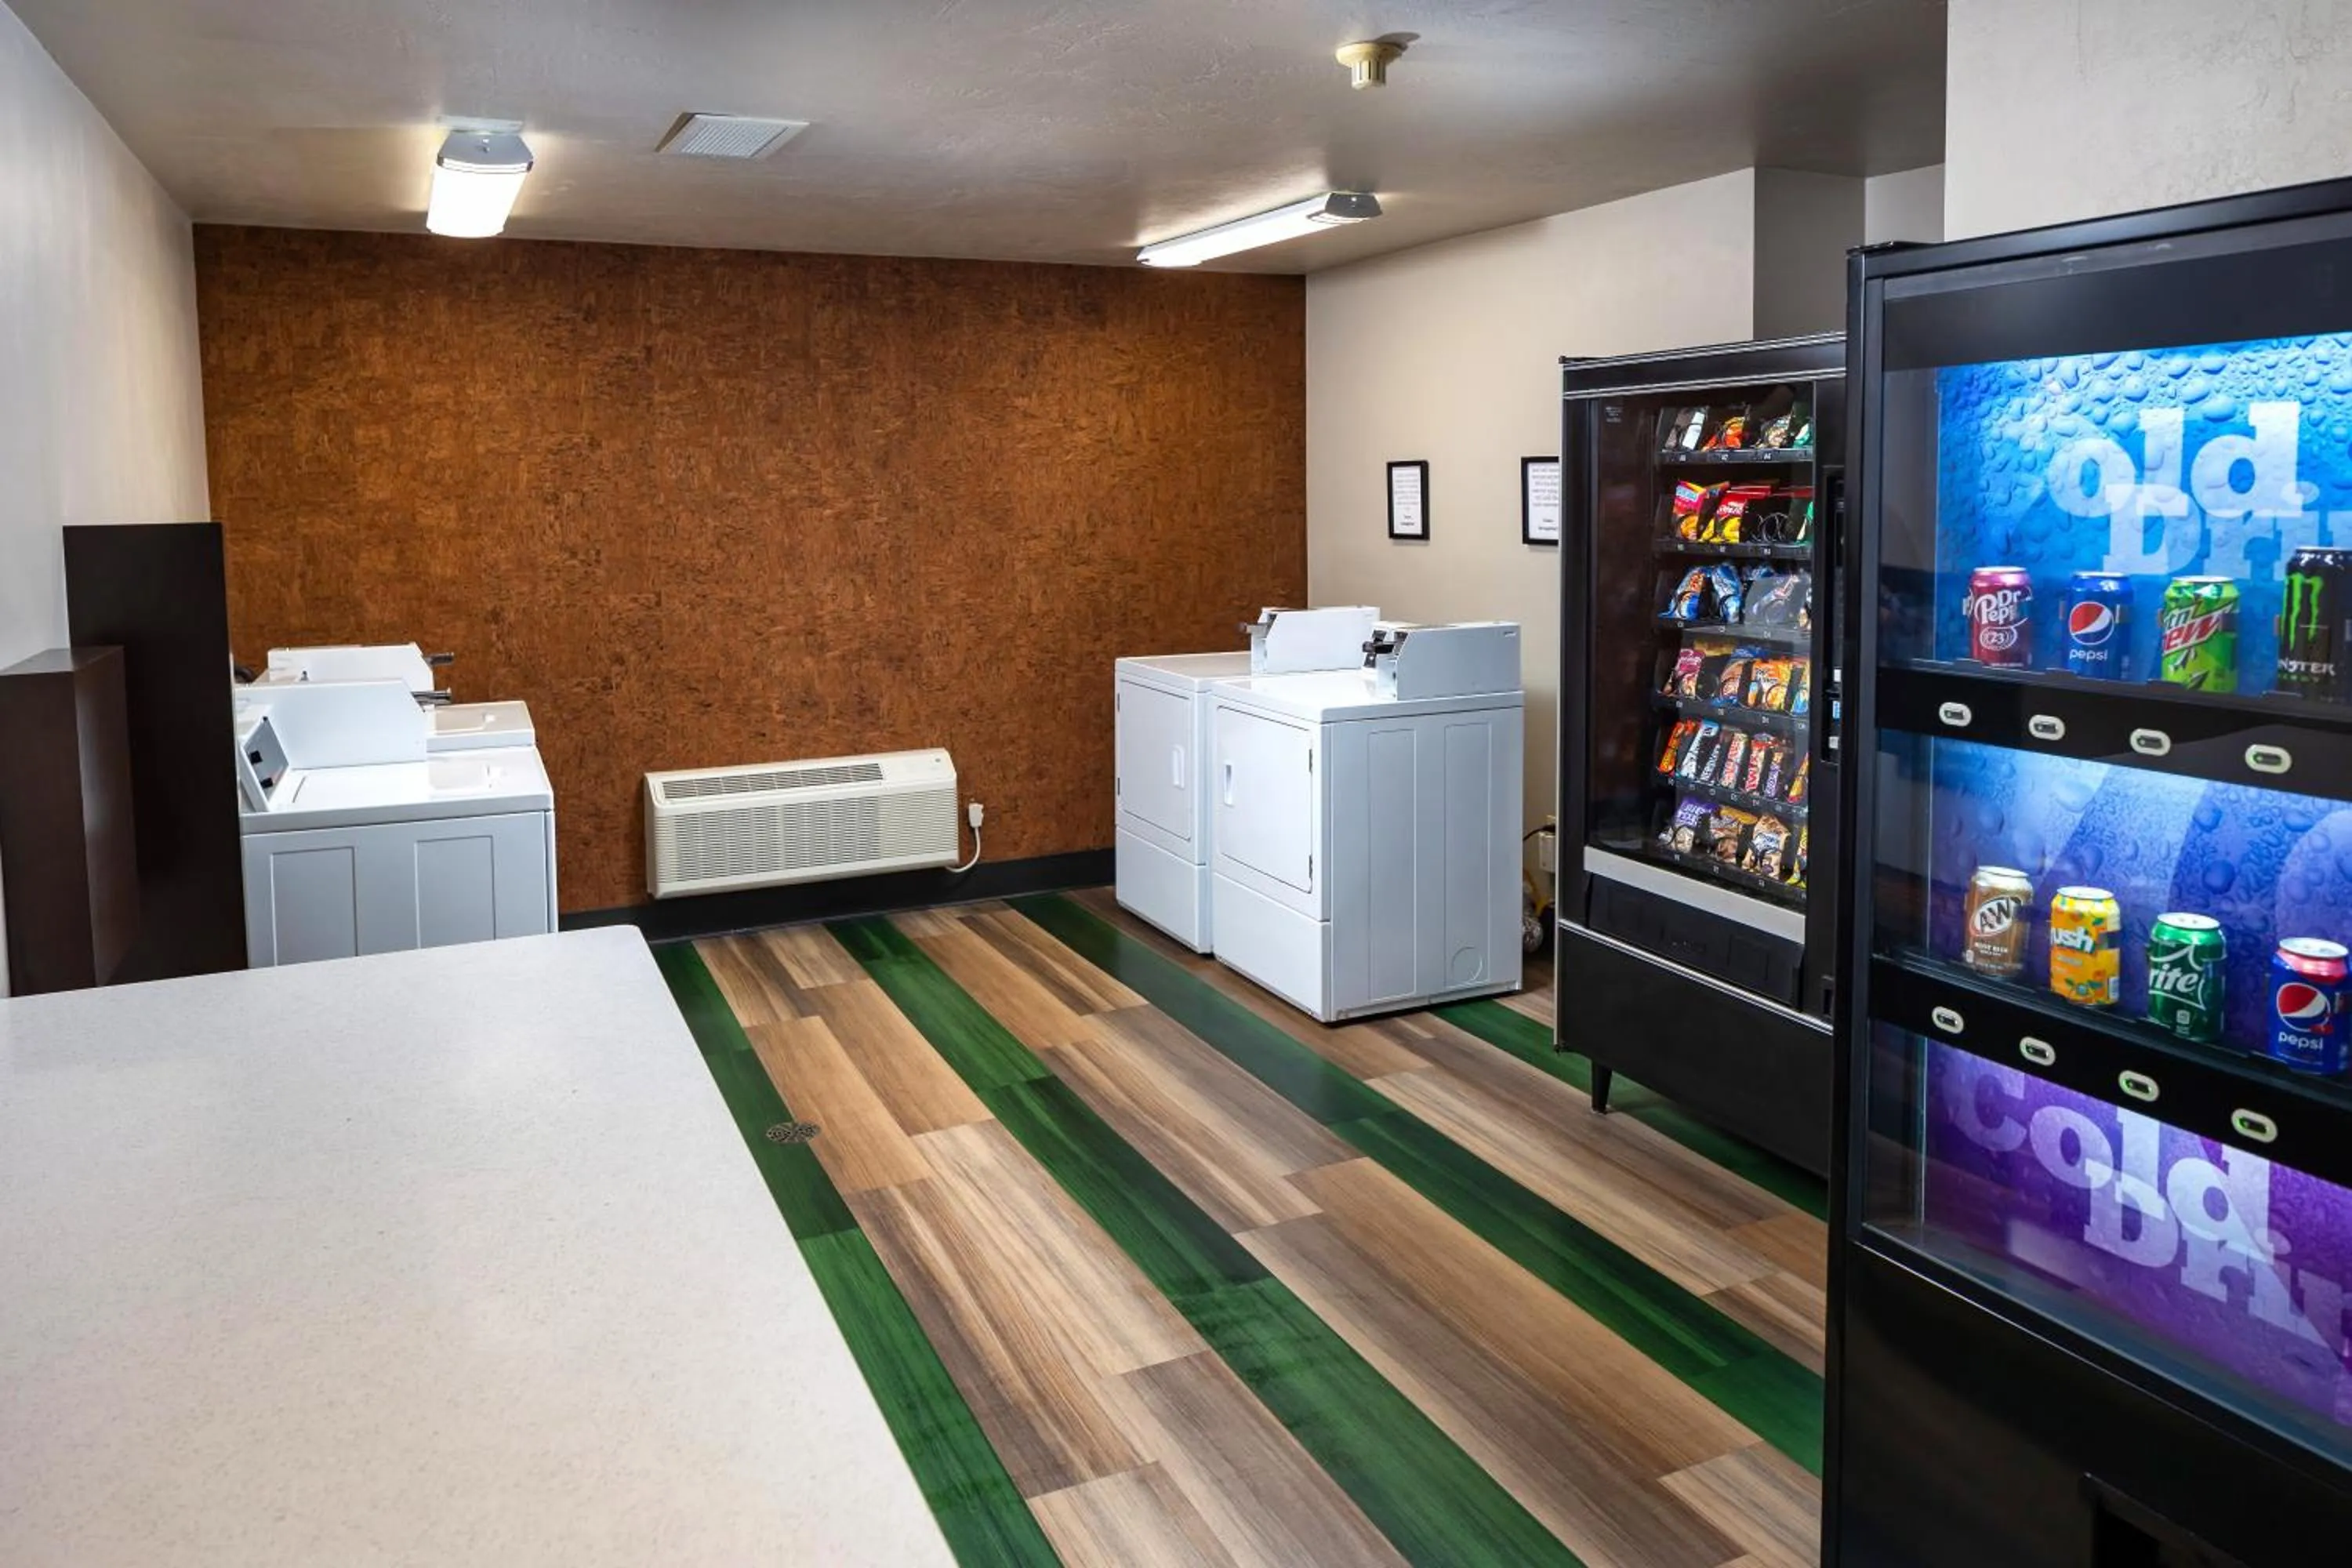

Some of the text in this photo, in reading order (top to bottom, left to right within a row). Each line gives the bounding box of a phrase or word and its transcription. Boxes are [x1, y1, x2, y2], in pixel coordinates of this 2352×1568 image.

[1997, 590, 2021, 607] Dr
[2069, 649, 2109, 662] pepsi
[2278, 1032, 2324, 1050] pepsi
[1942, 1044, 2272, 1262] Cold
